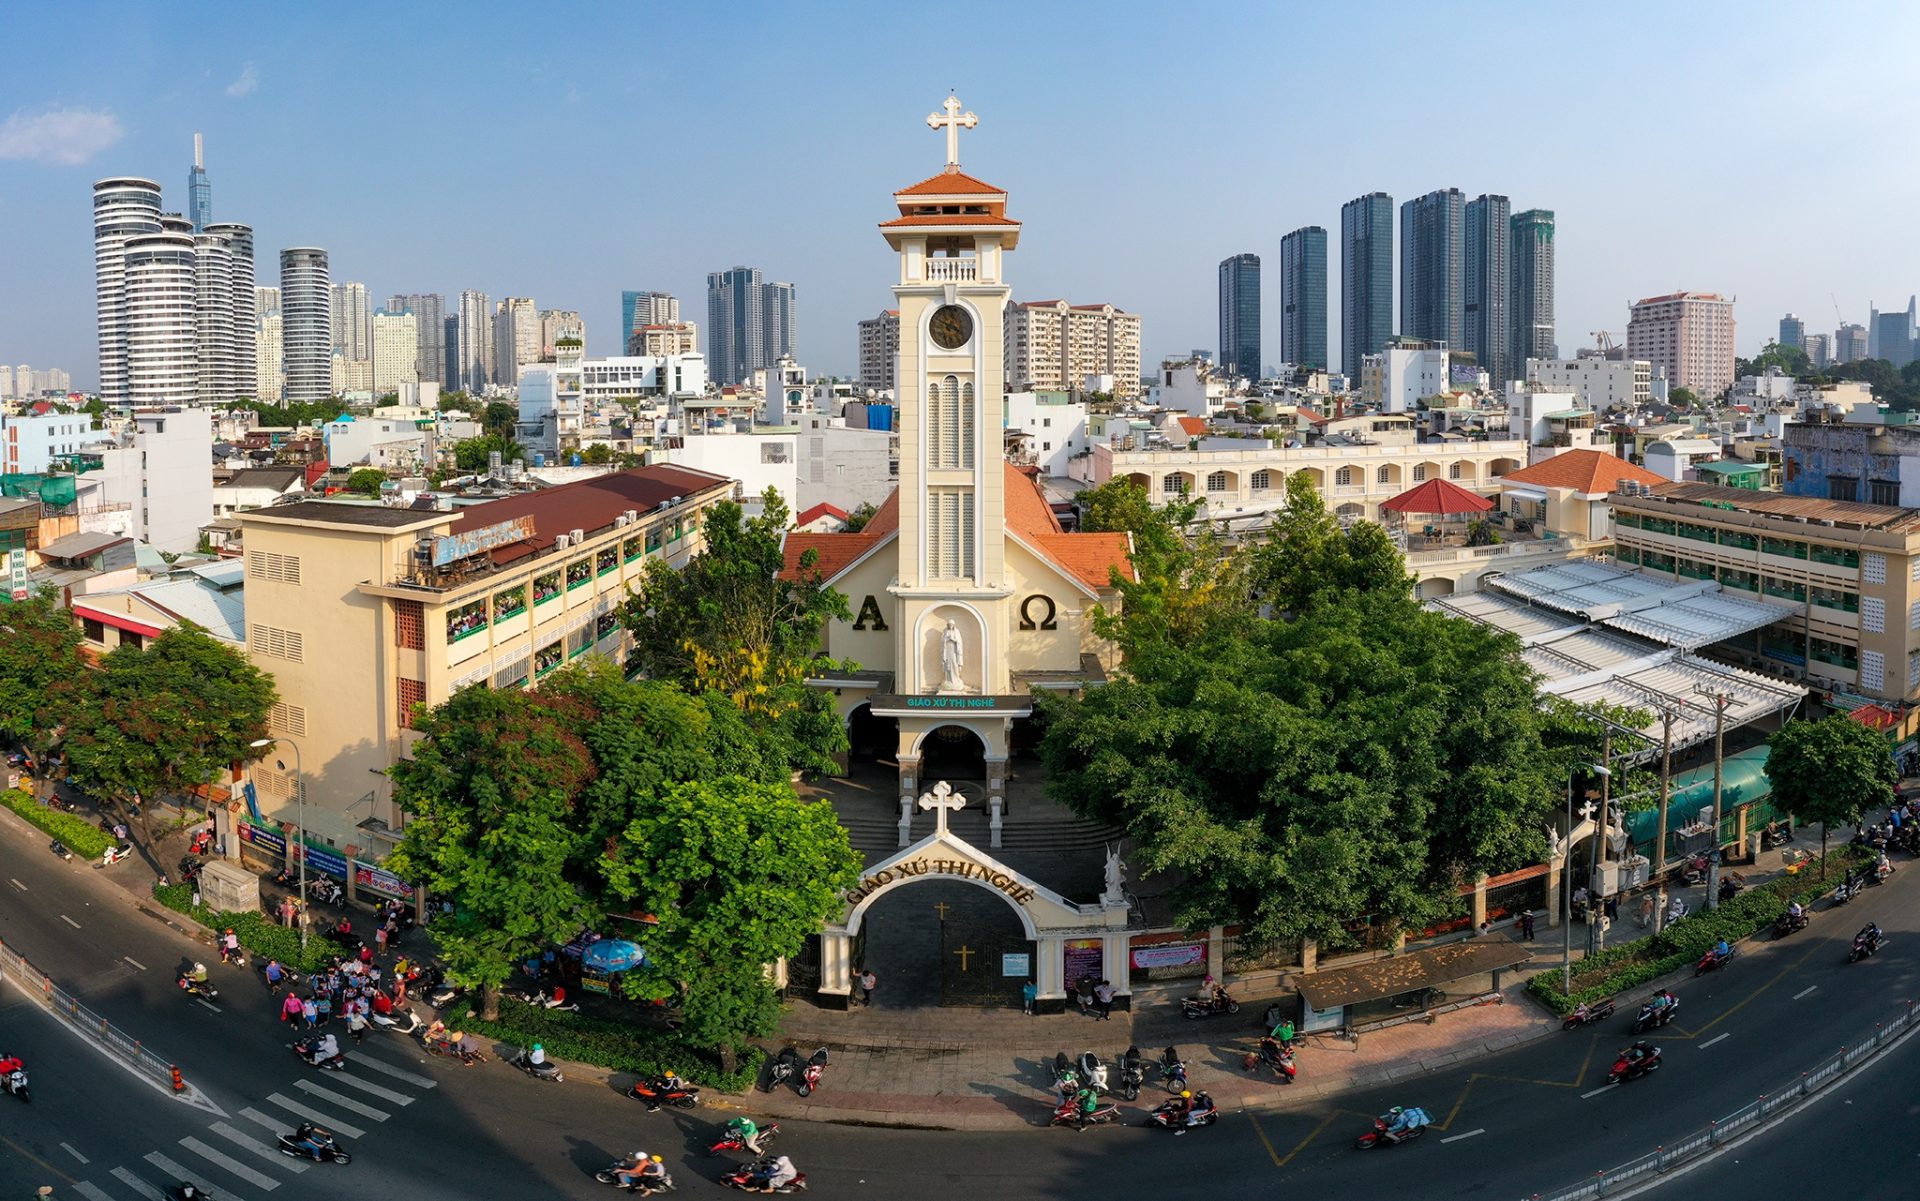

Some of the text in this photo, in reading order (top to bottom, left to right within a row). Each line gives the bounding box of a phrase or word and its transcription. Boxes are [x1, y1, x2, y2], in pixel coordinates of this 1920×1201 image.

[907, 697, 931, 707] GIÁO
[949, 698, 965, 708] THỊ
[846, 856, 1035, 906] GIÁO XỨ THỊ NGHÈ
